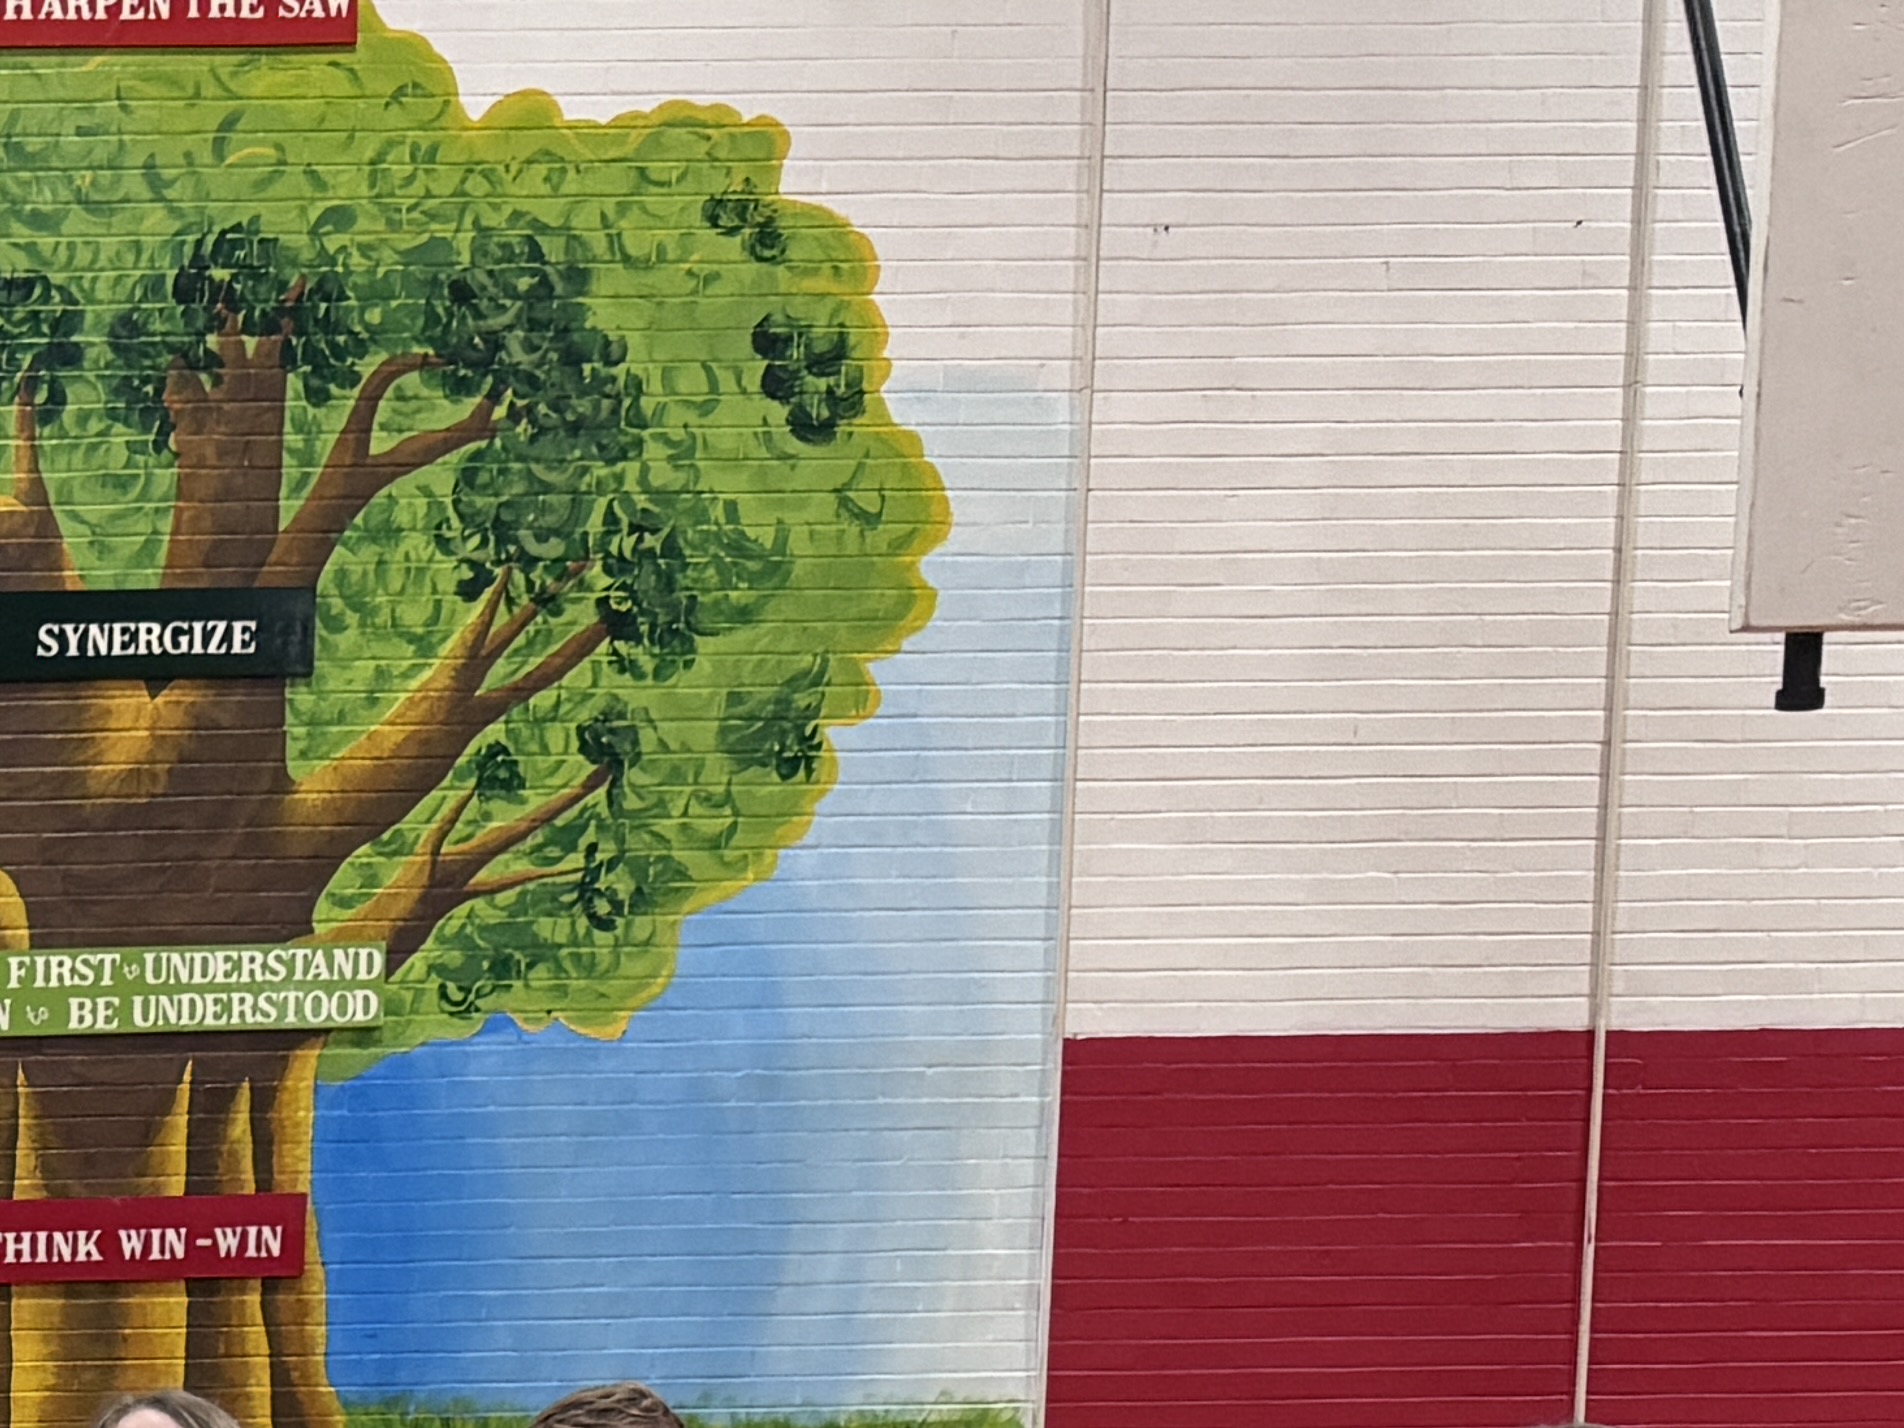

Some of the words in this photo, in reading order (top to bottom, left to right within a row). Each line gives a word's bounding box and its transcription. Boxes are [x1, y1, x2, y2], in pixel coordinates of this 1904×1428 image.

[187, 0, 264, 19] THE
[278, 0, 349, 18] SAW
[36, 620, 258, 658] SYNERGIZE
[8, 954, 120, 988] FIRST
[144, 947, 382, 985] UNDERSTAND
[68, 996, 119, 1029] BE
[132, 989, 380, 1028] UNDERSTOOD
